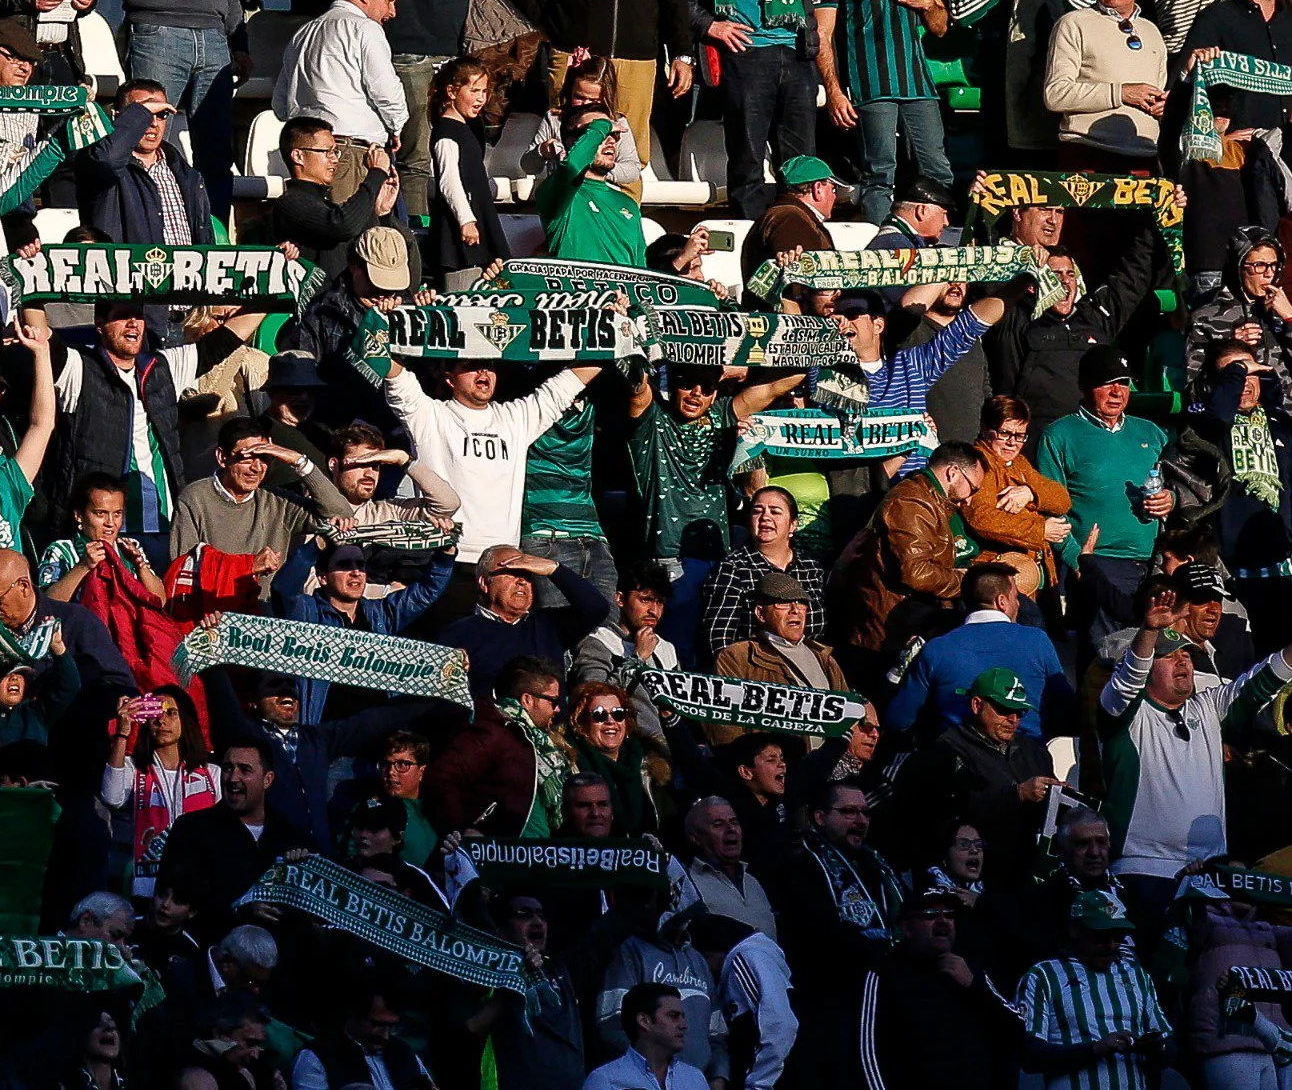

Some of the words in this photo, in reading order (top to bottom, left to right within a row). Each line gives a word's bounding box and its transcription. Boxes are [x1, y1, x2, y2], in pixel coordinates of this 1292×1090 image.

[1254, 59, 1292, 80] ETIS
[972, 174, 1048, 216] REAL
[817, 250, 897, 270] REAL
[917, 247, 1014, 266] BETIS
[14, 249, 135, 294] REAL
[172, 250, 305, 300] BETIS
[576, 267, 594, 279] POR
[868, 269, 966, 286] BALOMPIE
[388, 307, 466, 349] REAL
[529, 306, 616, 350] BETIS
[663, 312, 689, 336] AL
[690, 312, 747, 338] BETIS
[783, 315, 822, 330] FINAL
[666, 343, 727, 365] ALOMPIE
[769, 343, 809, 355] ESTADIO
[772, 355, 808, 367] MADRID
[783, 421, 841, 447] REAL
[867, 420, 925, 446] BETIS
[463, 437, 509, 460] ICON
[229, 626, 273, 653] Real
[282, 634, 330, 664] Betis
[641, 670, 732, 710] REAL
[738, 683, 848, 723] BETIS
[671, 701, 707, 716] OCOS
[711, 711, 731, 721] DE
[736, 714, 757, 725] LA
[760, 717, 826, 734] CABEZA
[1232, 874, 1283, 894] BETIS
[285, 865, 340, 907] REAL
[344, 893, 408, 936] BETIS
[13, 939, 125, 970] BETIS
